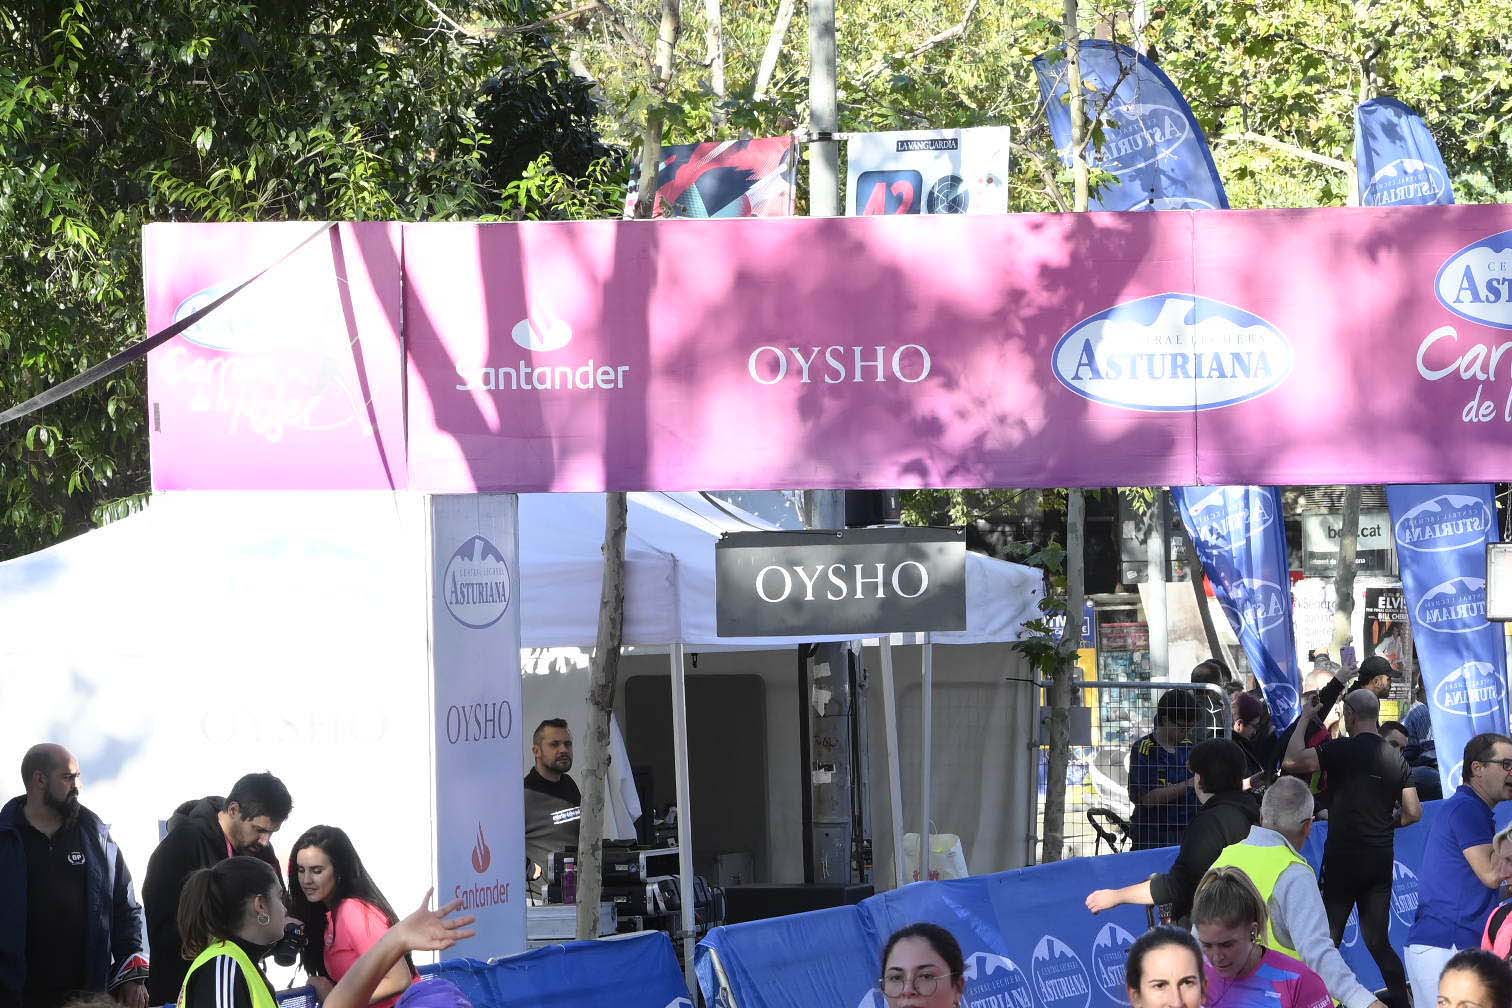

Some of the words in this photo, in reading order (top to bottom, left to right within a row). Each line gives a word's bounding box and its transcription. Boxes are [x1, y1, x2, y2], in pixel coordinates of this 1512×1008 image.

[909, 139, 959, 150] VANGUARDIA
[455, 358, 630, 392] Santander
[747, 343, 932, 385] OYSHO
[1071, 338, 1274, 381] ASTURIANA
[1462, 387, 1497, 423] de
[449, 569, 508, 606] ASTURIANA
[755, 561, 930, 603] OYSHO
[1378, 596, 1407, 609] ELVI
[447, 700, 513, 745] OYSHO
[454, 879, 510, 913] Santander
[1036, 970, 1089, 1003] ASTURIANA
